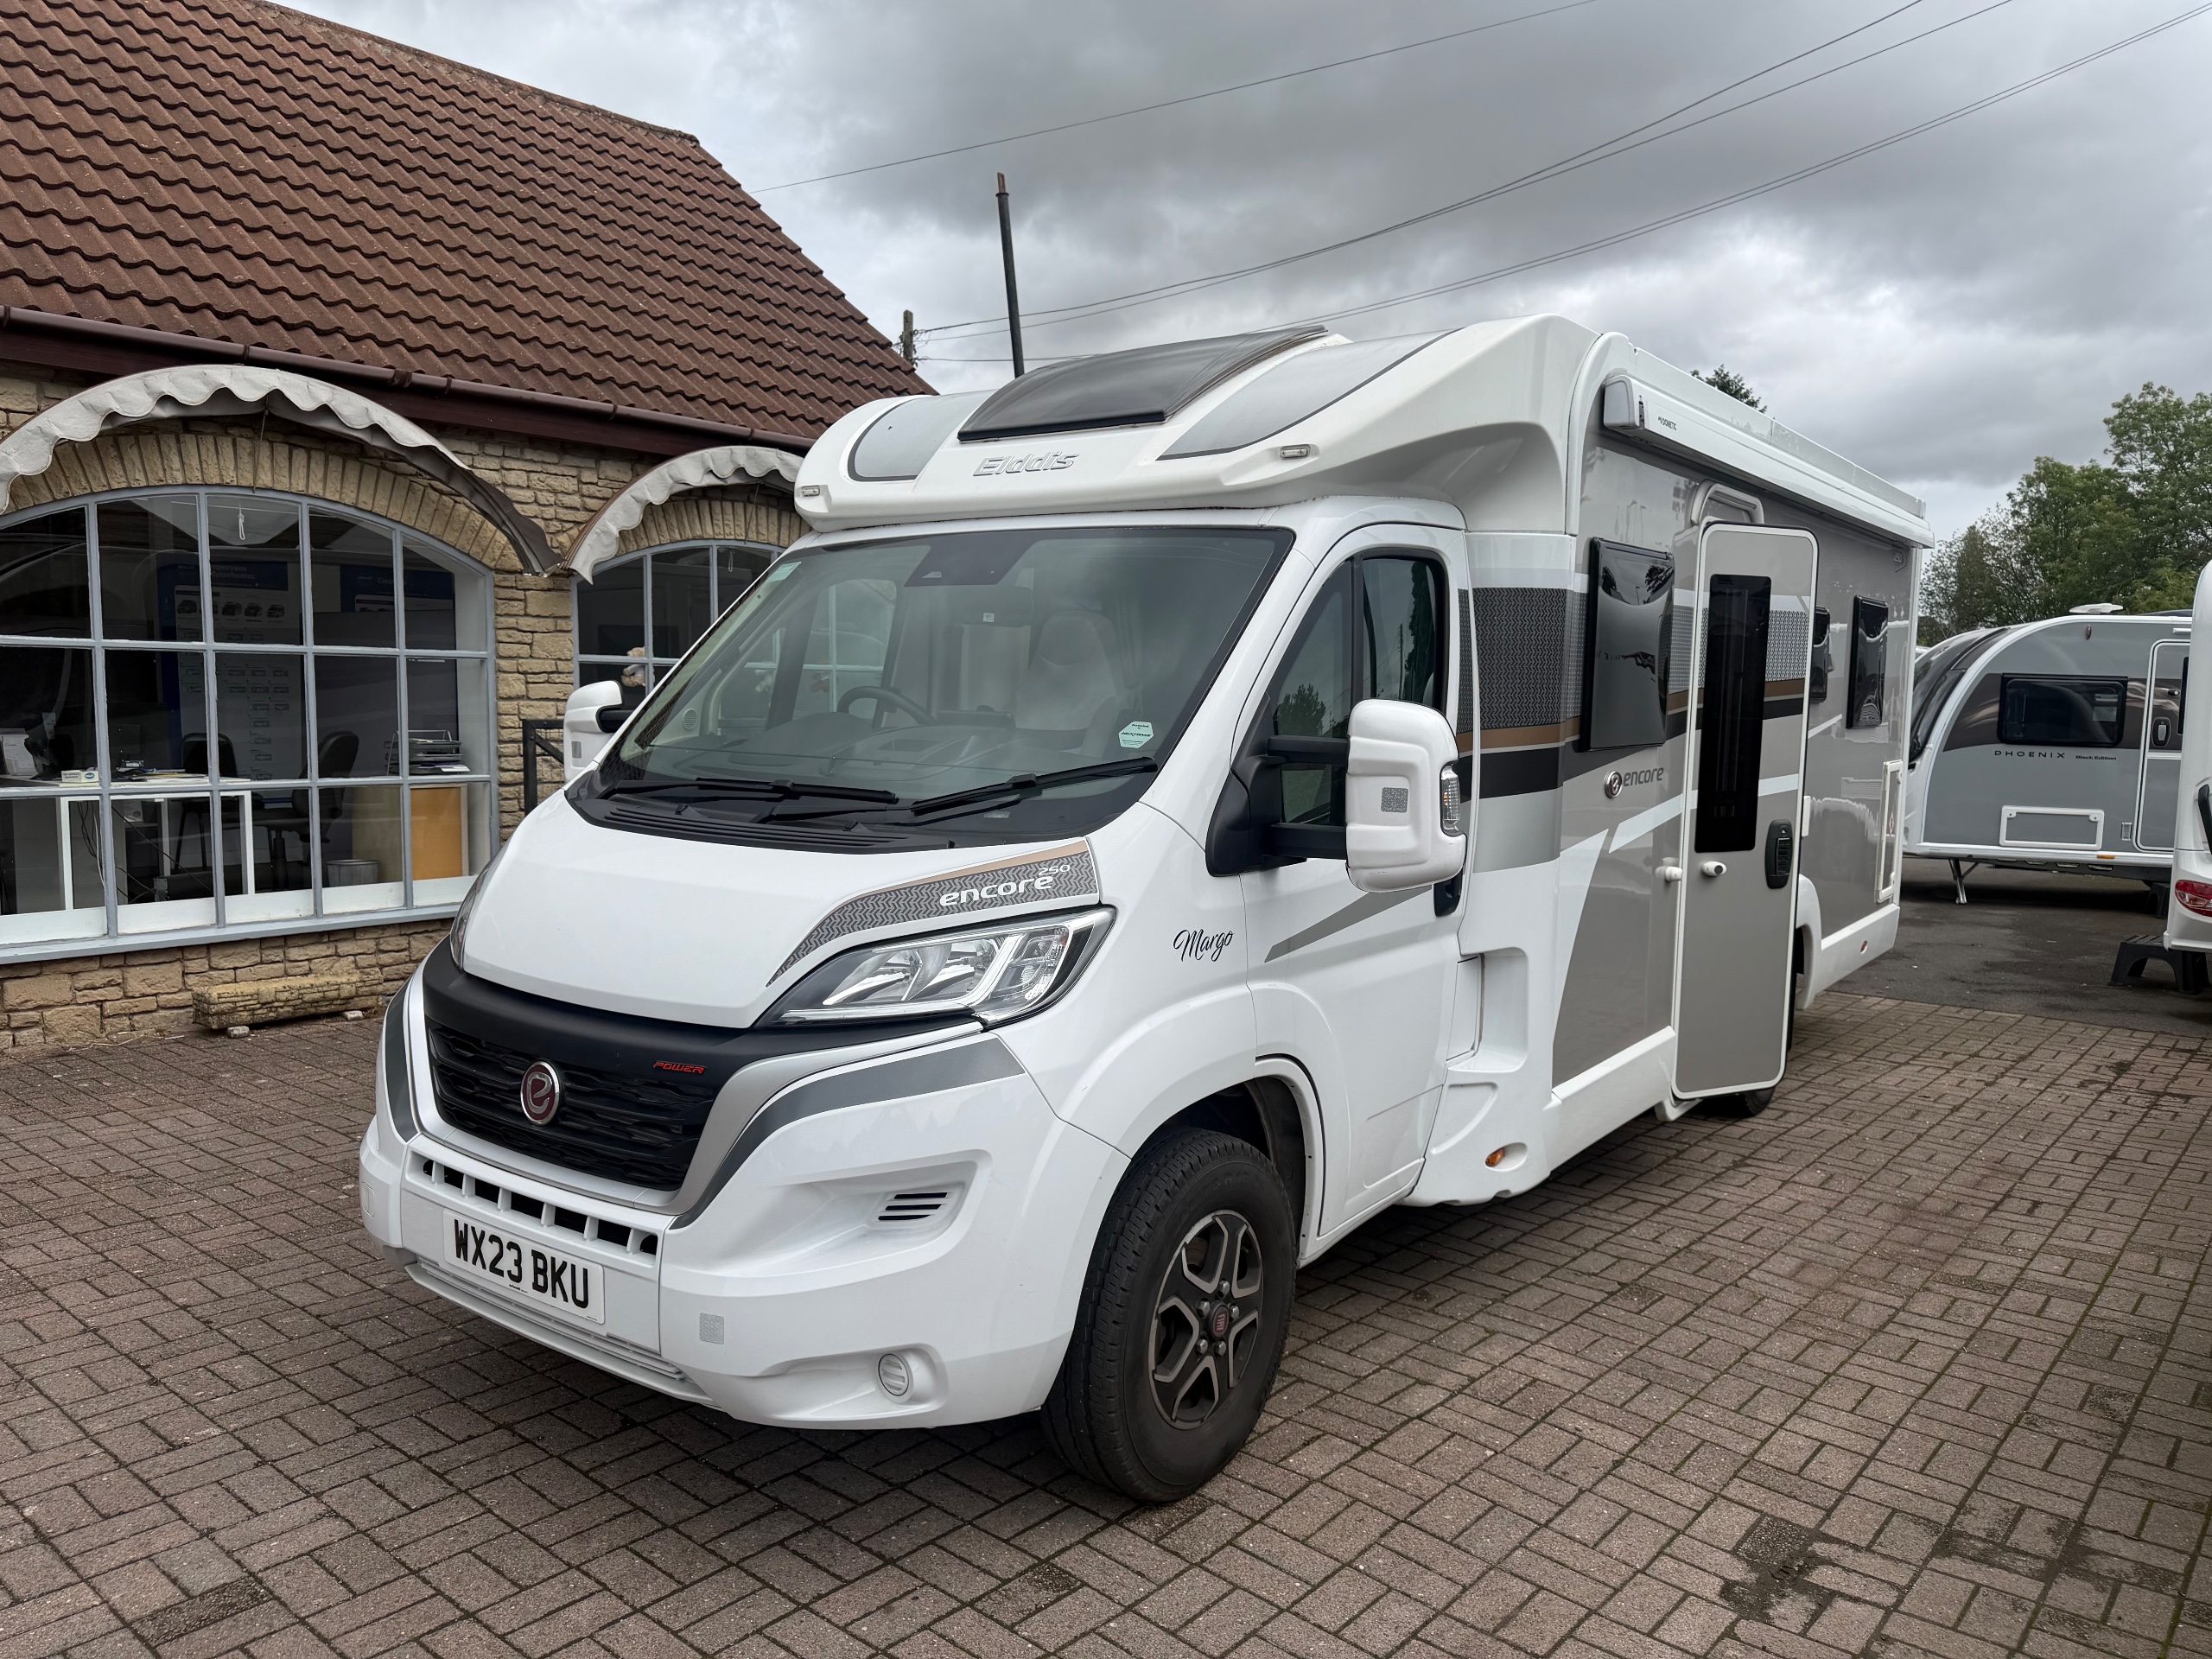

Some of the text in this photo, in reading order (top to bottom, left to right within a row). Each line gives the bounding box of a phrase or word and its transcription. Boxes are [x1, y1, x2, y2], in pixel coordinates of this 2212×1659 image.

[973, 451, 1079, 476] Elddis
[1994, 750, 2065, 759] PHOENIX
[1624, 767, 1664, 786] encore
[939, 864, 1071, 906] encore 250
[1173, 929, 1235, 962] Margo
[653, 1061, 705, 1075] POWER
[454, 1218, 589, 1309] WX23 BKU
[1216, 1313, 1225, 1331] FIAT
